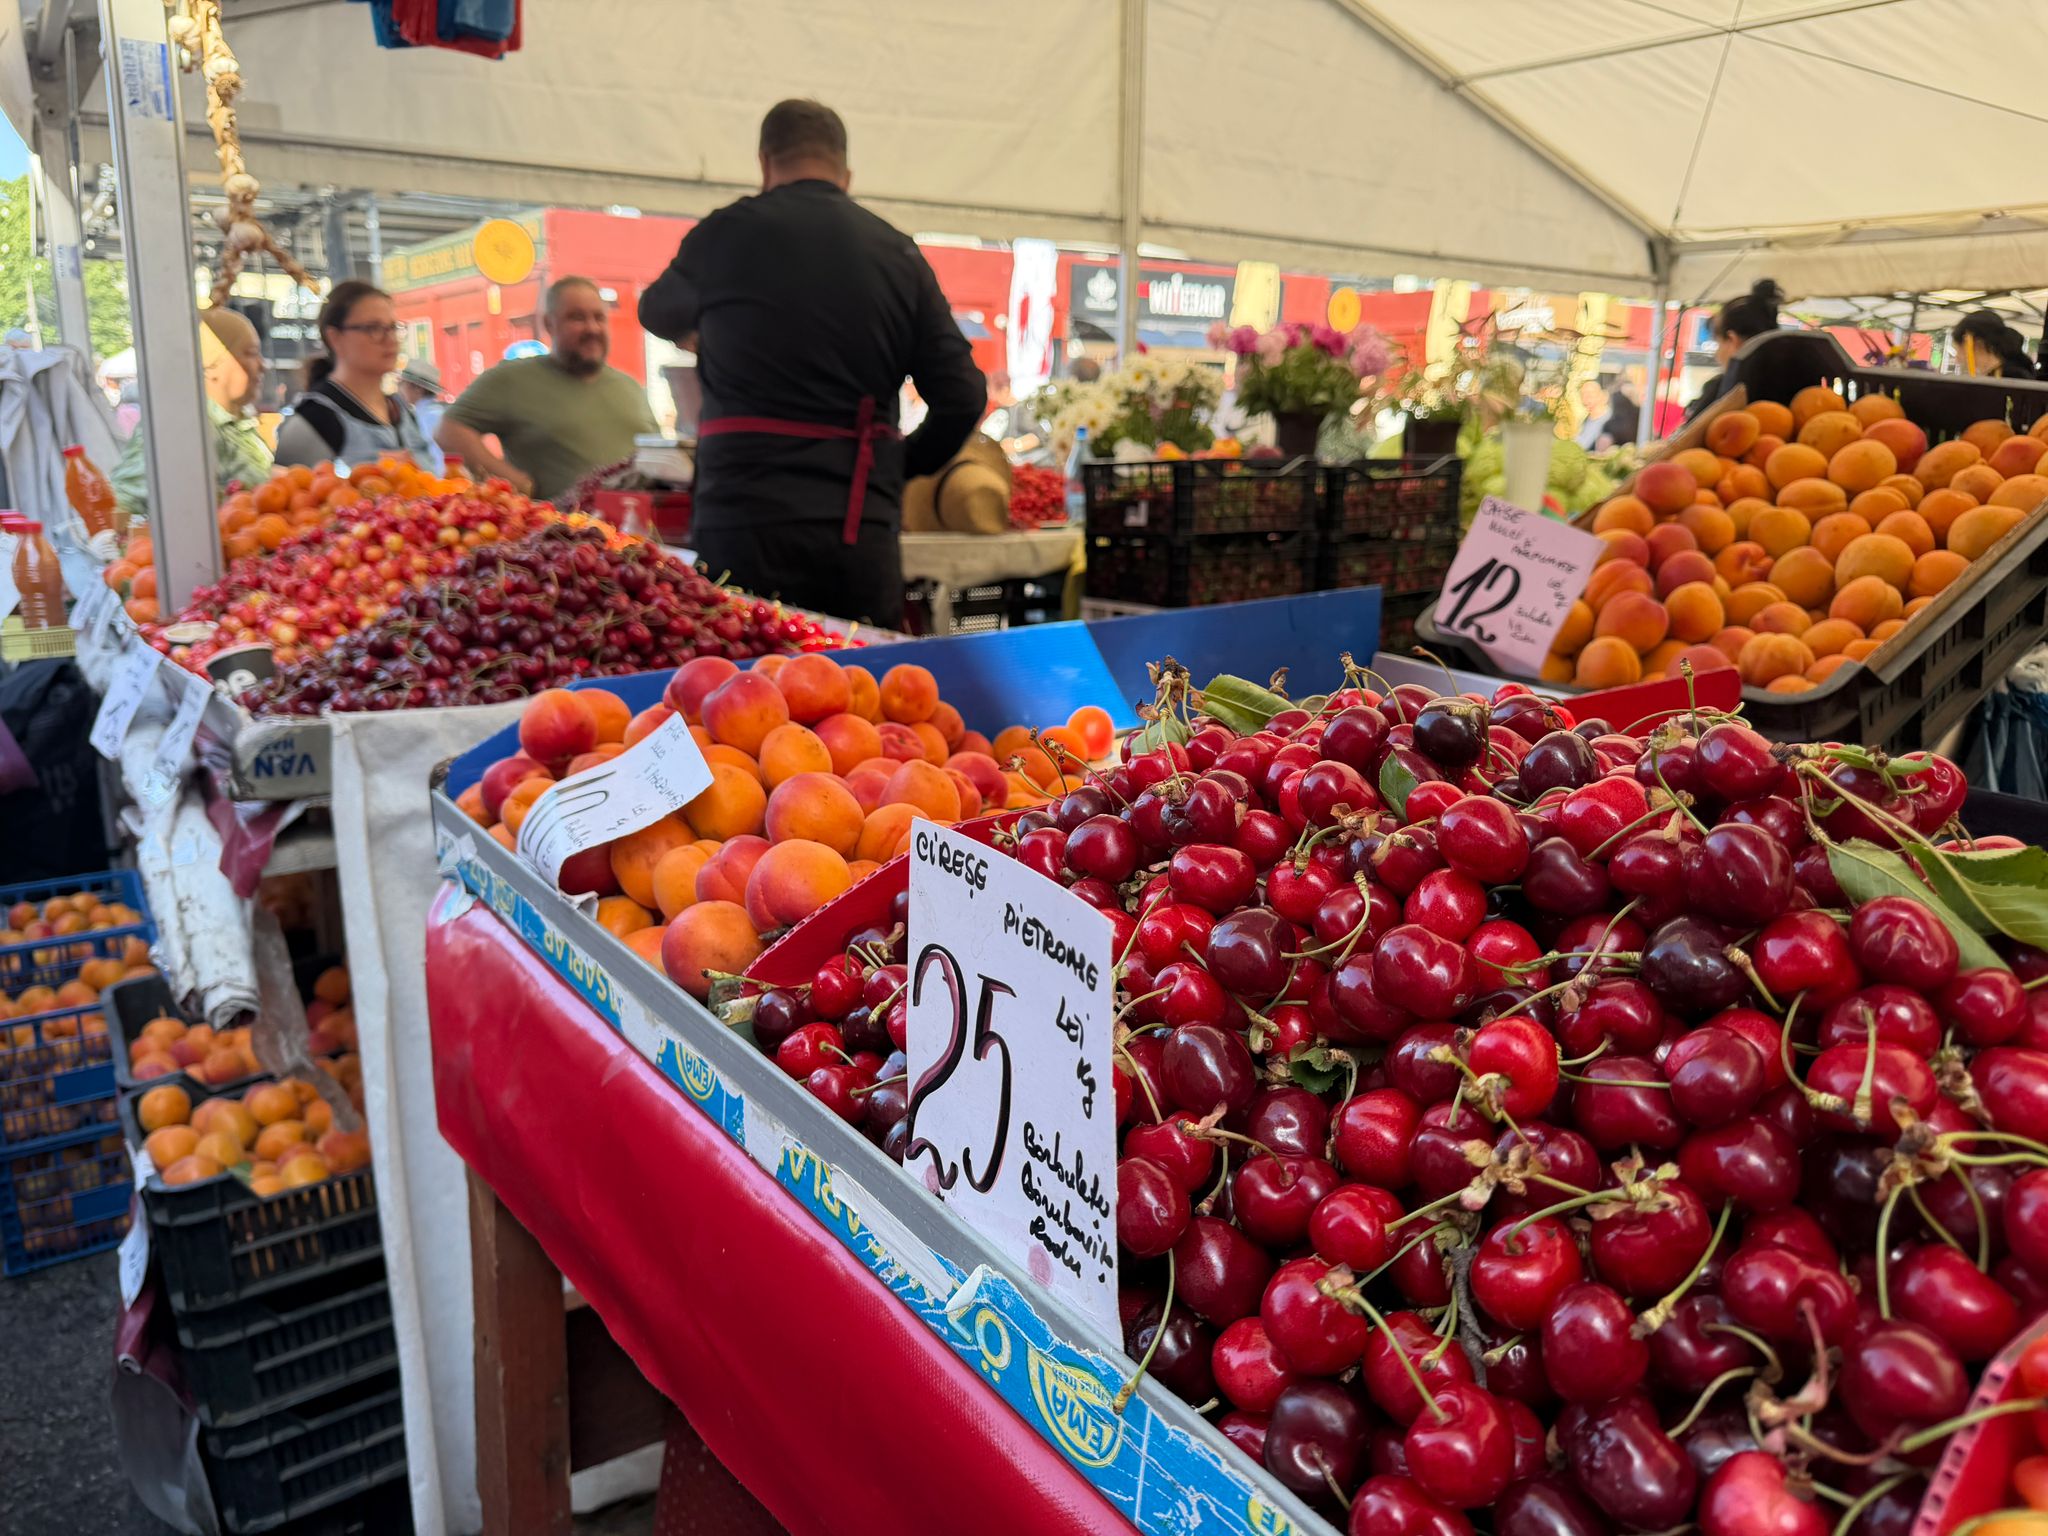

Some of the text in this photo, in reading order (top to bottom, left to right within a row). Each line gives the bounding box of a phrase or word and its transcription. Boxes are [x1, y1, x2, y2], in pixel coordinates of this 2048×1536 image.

[1445, 558, 1520, 642] 12
[905, 943, 1017, 1193] 25
[1052, 1383, 1104, 1453] EMA
